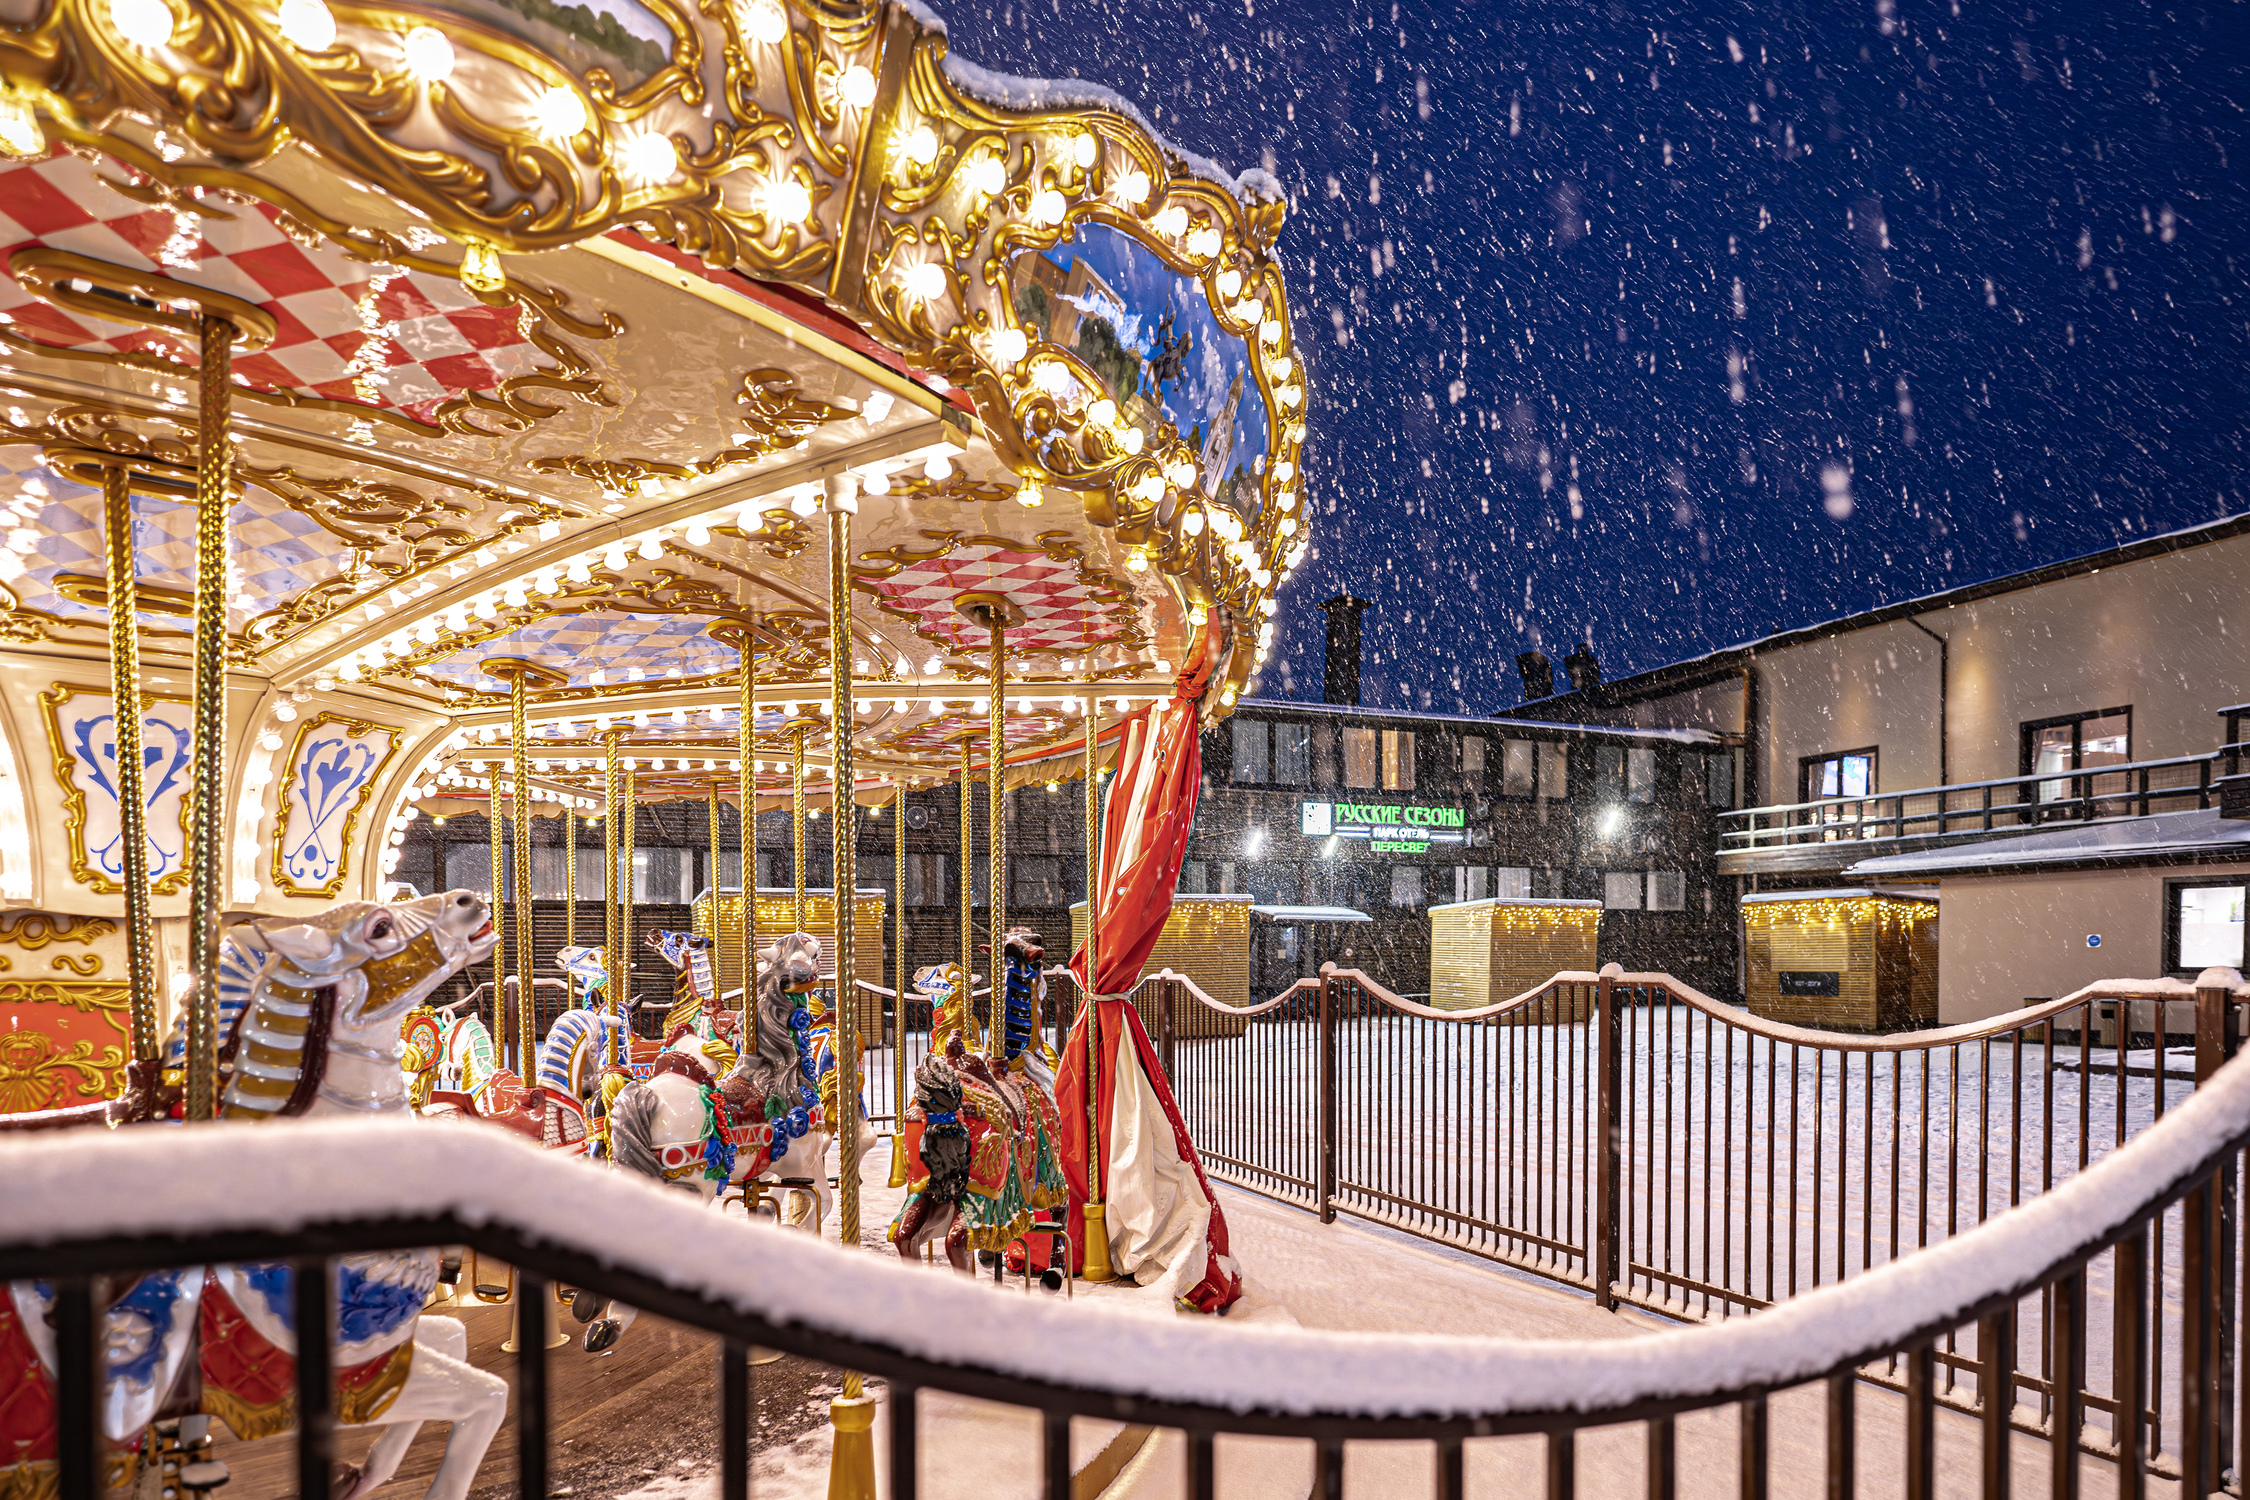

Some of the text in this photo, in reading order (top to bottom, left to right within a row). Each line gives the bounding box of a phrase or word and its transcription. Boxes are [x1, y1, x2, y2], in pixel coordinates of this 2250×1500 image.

[1336, 803, 1465, 828] РУССКИЕ СЕЗОНЫ
[1373, 827, 1430, 839] ПАРК ОТЕЛЬ
[1371, 840, 1431, 854] ПЕРЕСВЕТ
